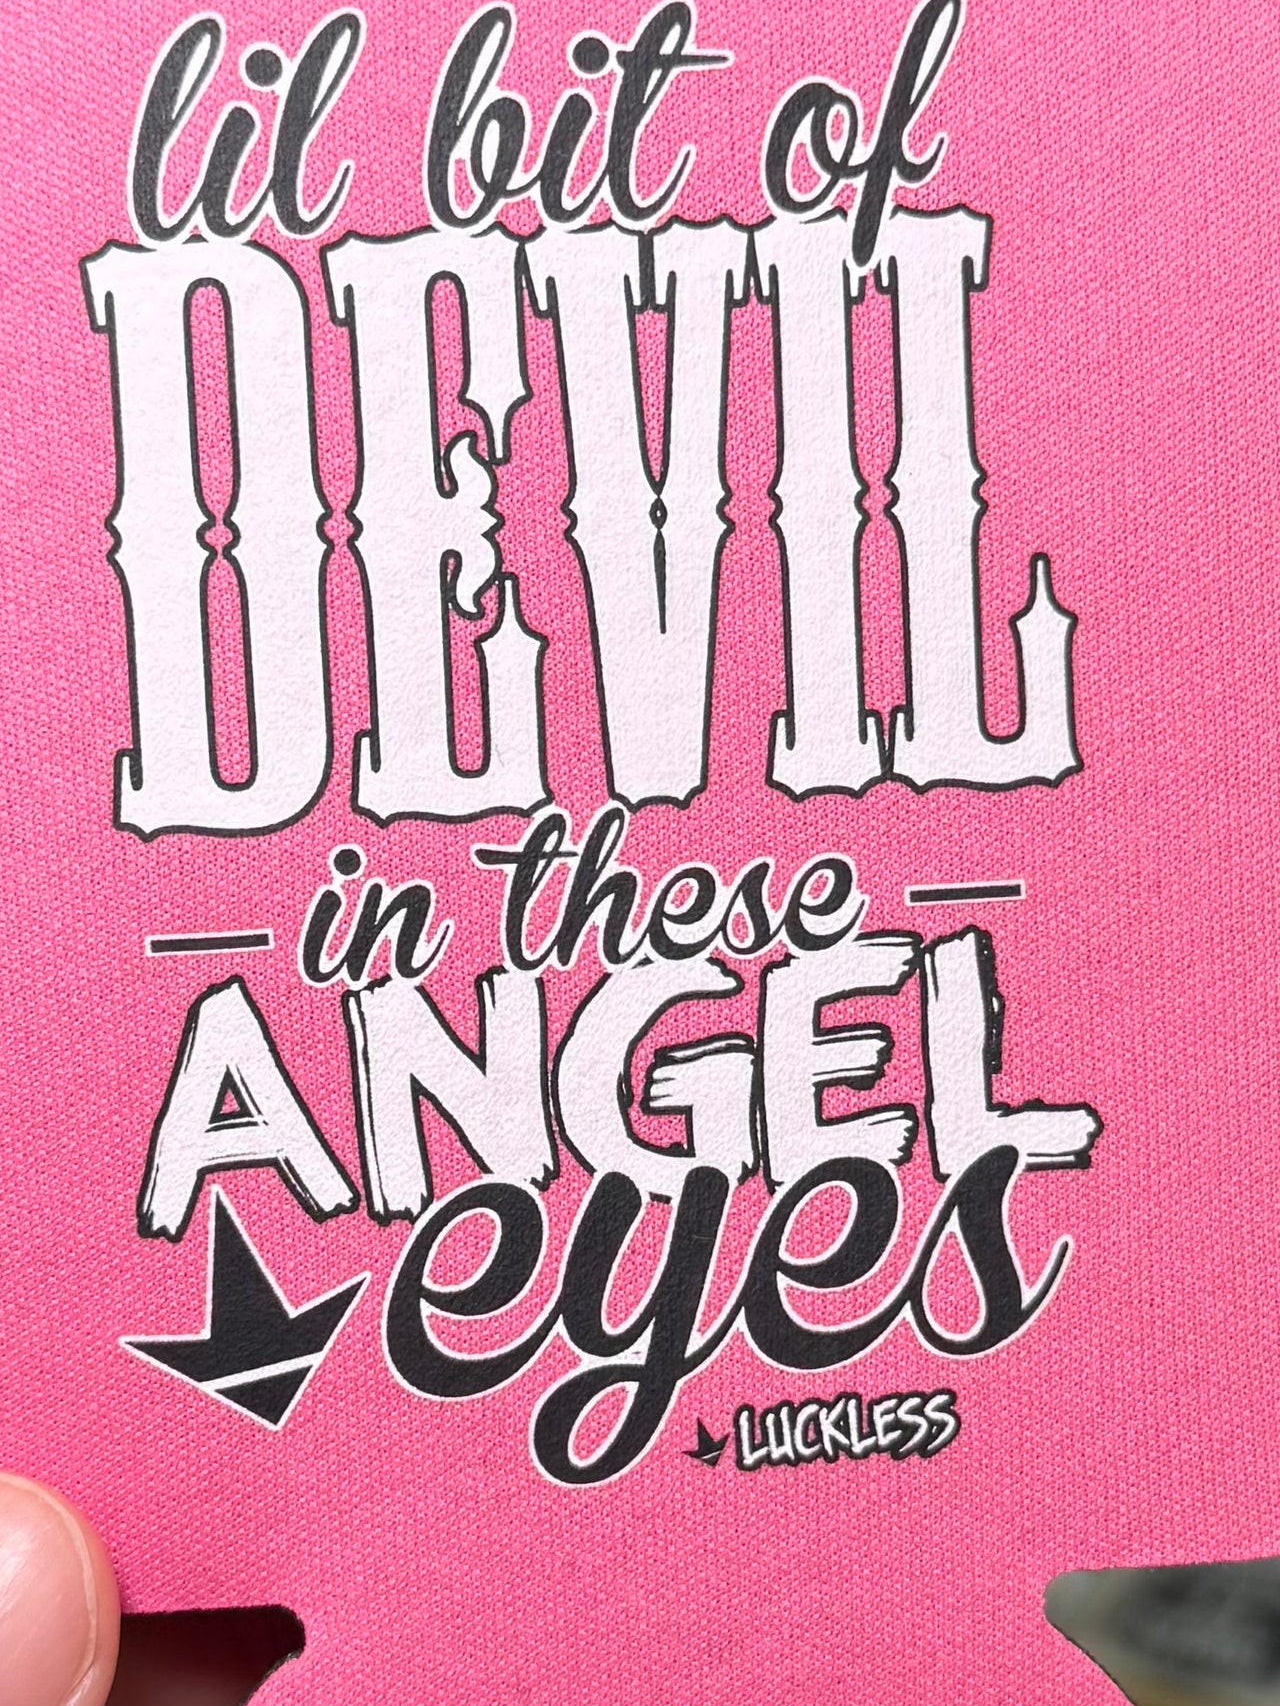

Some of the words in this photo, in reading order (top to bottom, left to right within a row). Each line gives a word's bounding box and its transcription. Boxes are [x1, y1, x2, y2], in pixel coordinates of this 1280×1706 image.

[126, 6, 365, 247] lil
[423, 0, 732, 231] bit
[82, 203, 1082, 837] DEVIL
[298, 845, 450, 986] in
[474, 803, 864, 972] these
[137, 927, 1104, 1240] ANGEL
[384, 1144, 1073, 1488] eyes
[733, 1388, 962, 1472] LUCKLESS
